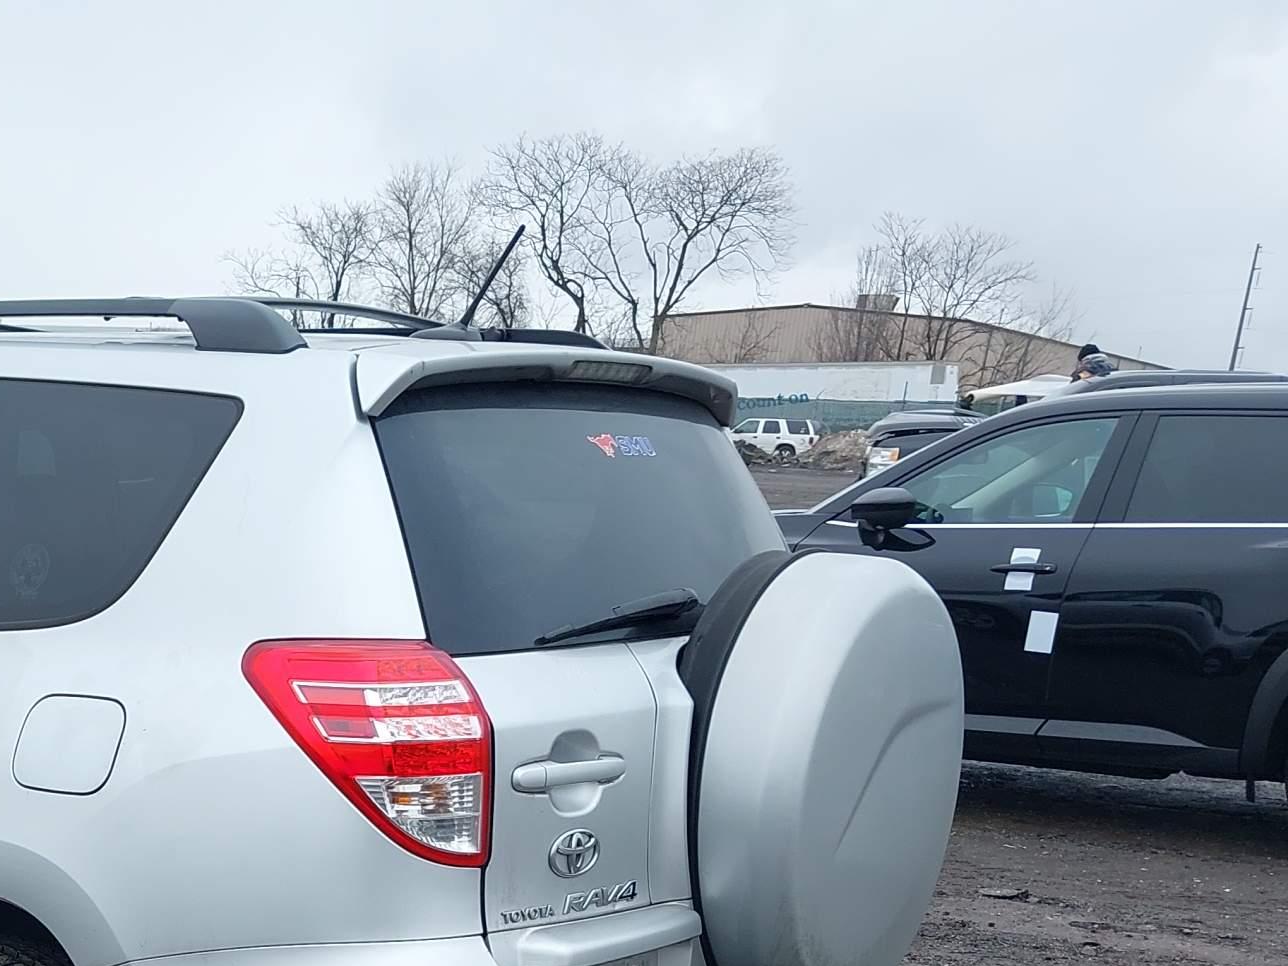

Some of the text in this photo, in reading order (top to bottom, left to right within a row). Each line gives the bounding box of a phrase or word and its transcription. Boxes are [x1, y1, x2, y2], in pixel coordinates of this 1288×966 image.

[615, 434, 657, 457] SMU
[500, 879, 638, 925] TOYOTA RAV4
